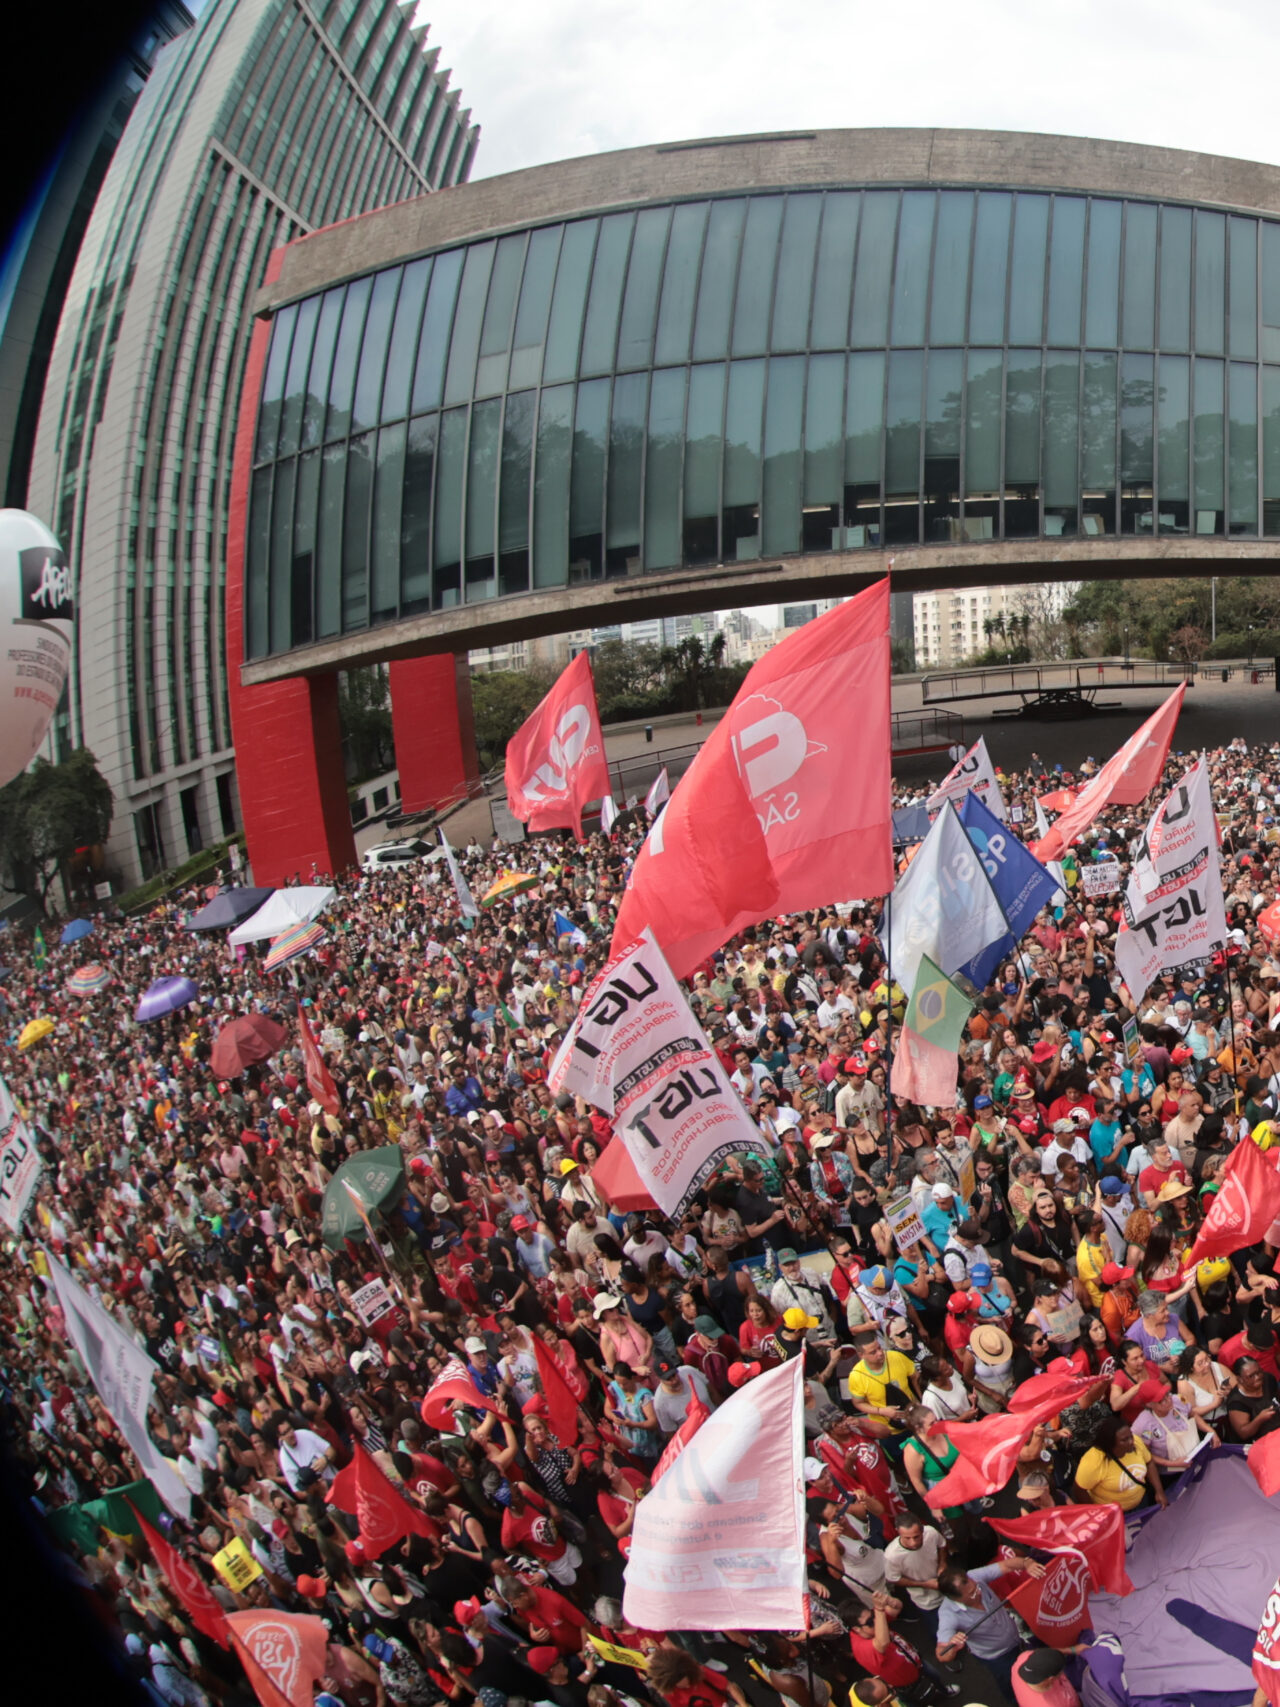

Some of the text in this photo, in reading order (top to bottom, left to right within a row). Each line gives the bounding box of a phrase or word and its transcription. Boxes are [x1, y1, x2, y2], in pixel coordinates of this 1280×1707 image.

[895, 1212, 918, 1234] SEM
[898, 1220, 924, 1245] ANISTIA
[355, 1290, 370, 1305] PEC
[369, 1285, 383, 1295] DA
